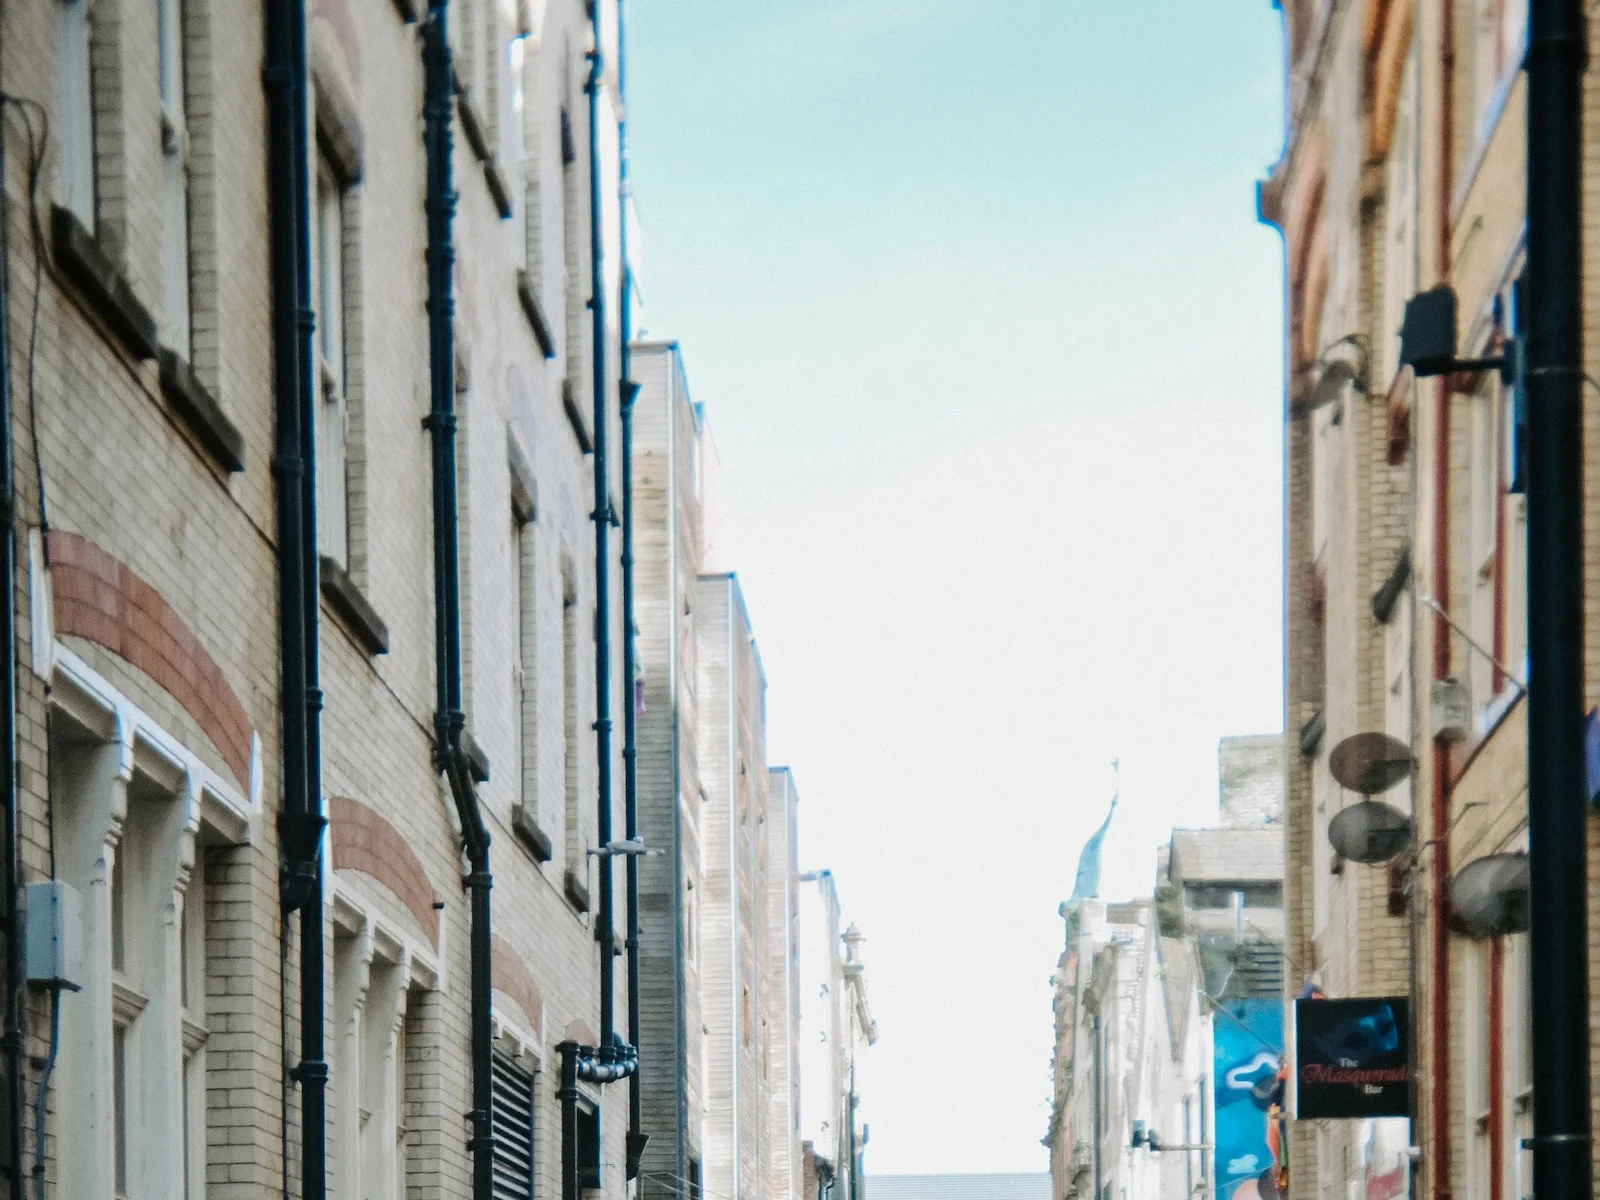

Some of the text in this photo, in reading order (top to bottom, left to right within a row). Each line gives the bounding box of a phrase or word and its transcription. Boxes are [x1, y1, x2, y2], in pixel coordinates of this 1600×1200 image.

[1340, 1057, 1359, 1068] The
[1301, 1064, 1408, 1086] Masquerad
[1364, 1084, 1383, 1094] Bar
